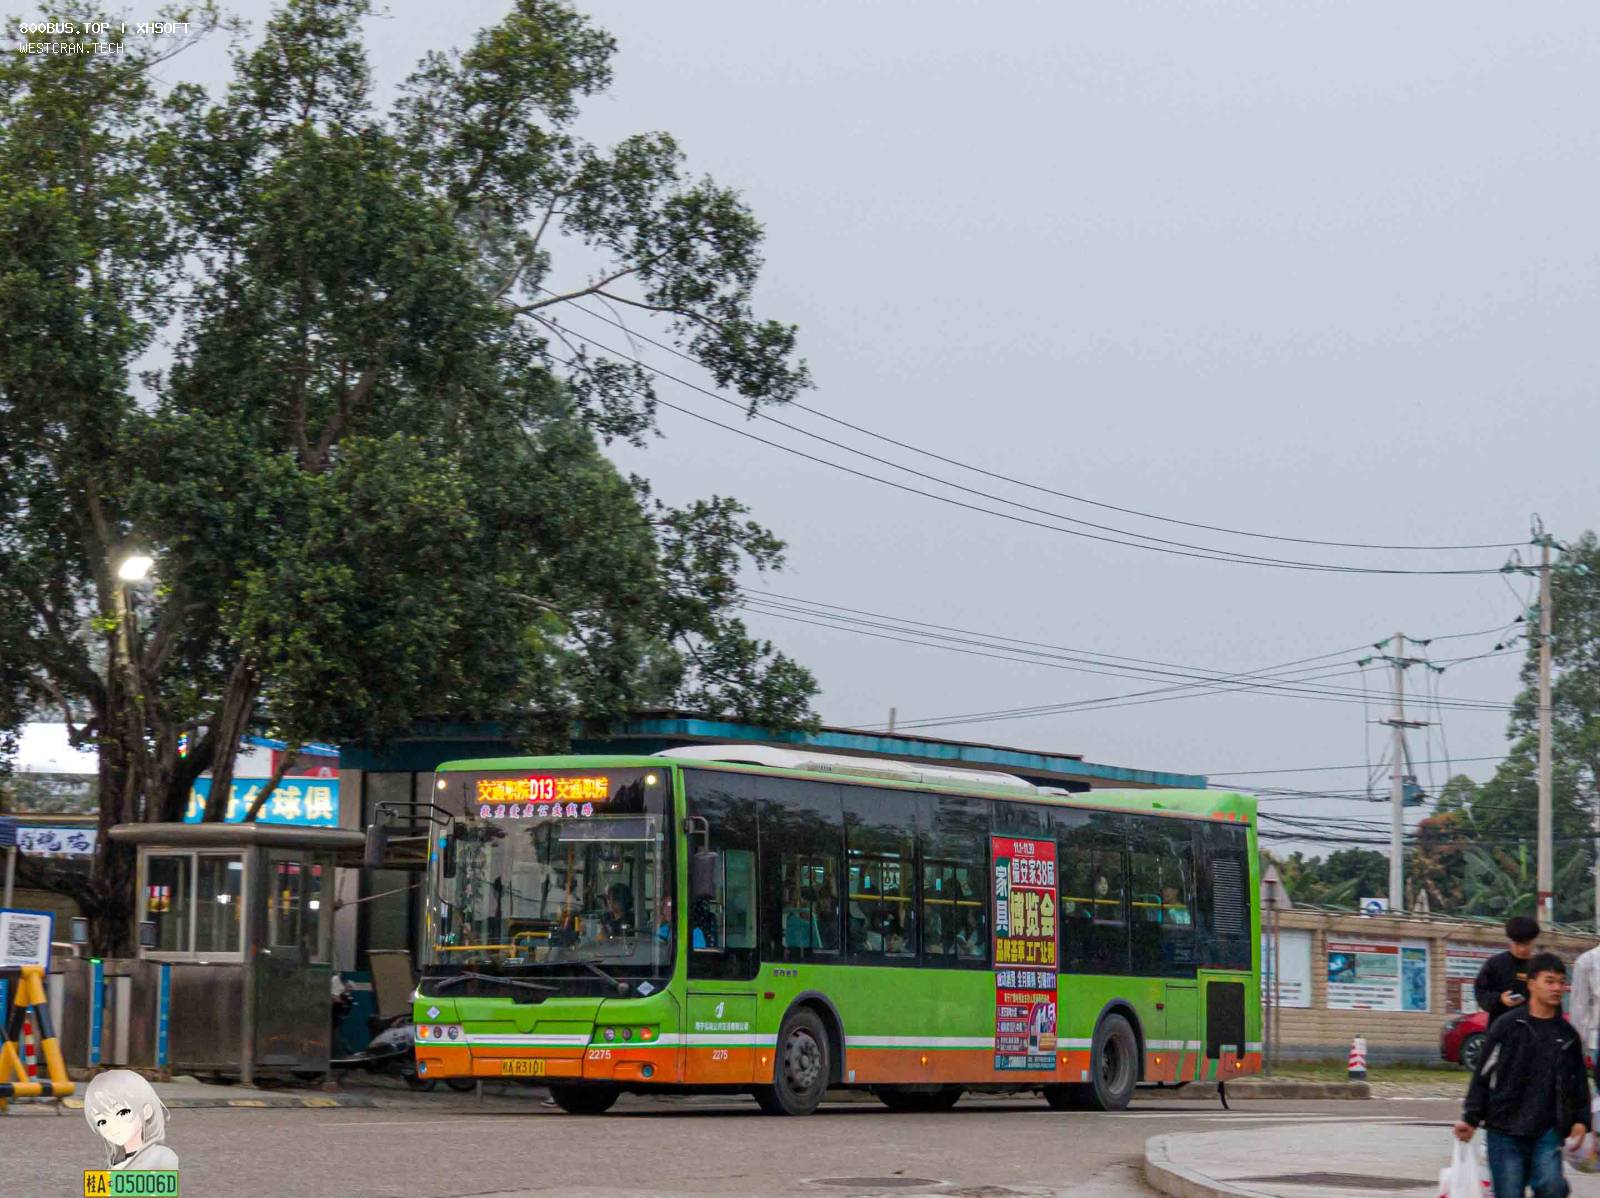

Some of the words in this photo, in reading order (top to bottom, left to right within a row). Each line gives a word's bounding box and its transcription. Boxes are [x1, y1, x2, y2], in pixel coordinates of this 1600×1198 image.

[529, 778, 554, 800] D13
[588, 1049, 612, 1060] 2275
[712, 1049, 728, 1060] 2275
